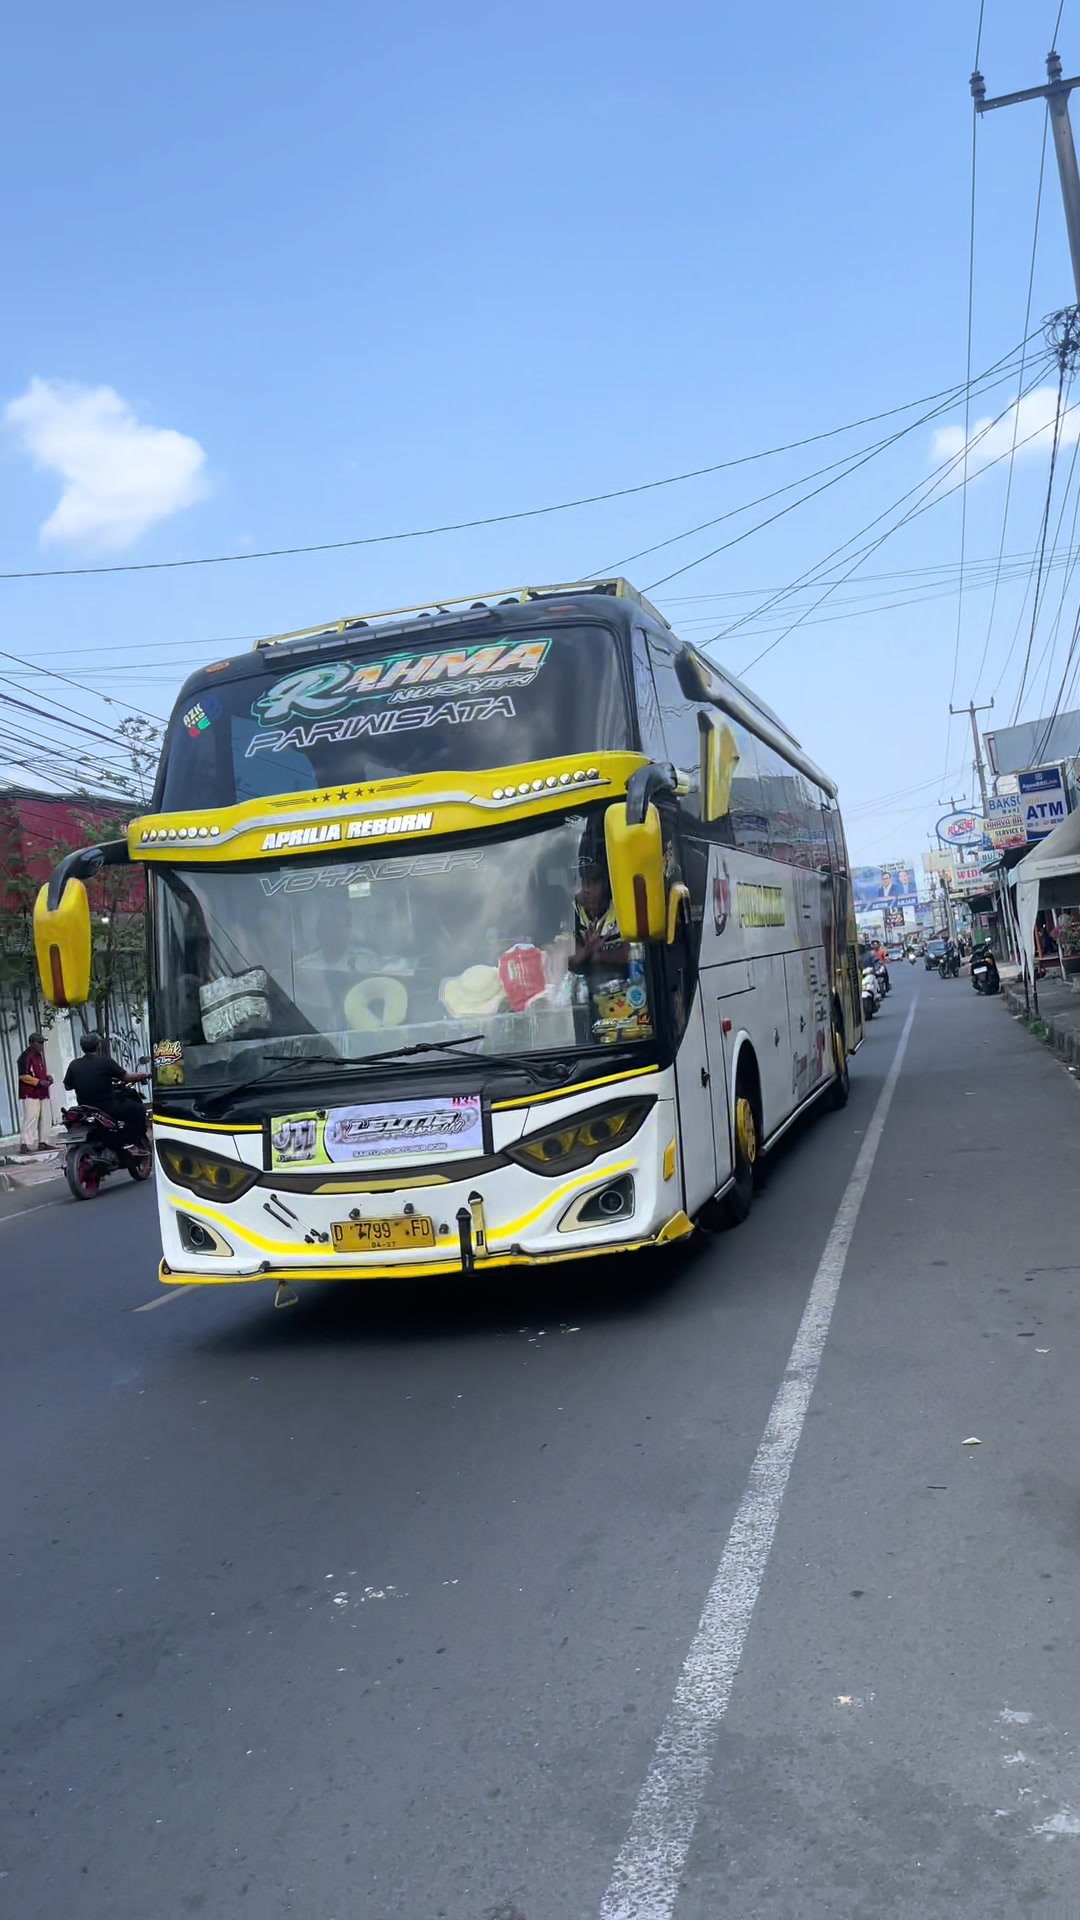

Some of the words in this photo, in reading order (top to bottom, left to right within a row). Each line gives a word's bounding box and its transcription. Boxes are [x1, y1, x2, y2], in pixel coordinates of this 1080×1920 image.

[252, 640, 552, 725] RAHMA
[245, 696, 516, 758] PARIWISATA
[261, 823, 342, 851] APRILIA
[346, 812, 435, 839] REBORN
[1027, 801, 1063, 820] ATM
[259, 850, 485, 897] VOYAGER
[334, 1224, 343, 1241] D
[355, 1221, 391, 1240] 7799
[411, 1218, 430, 1236] FD
